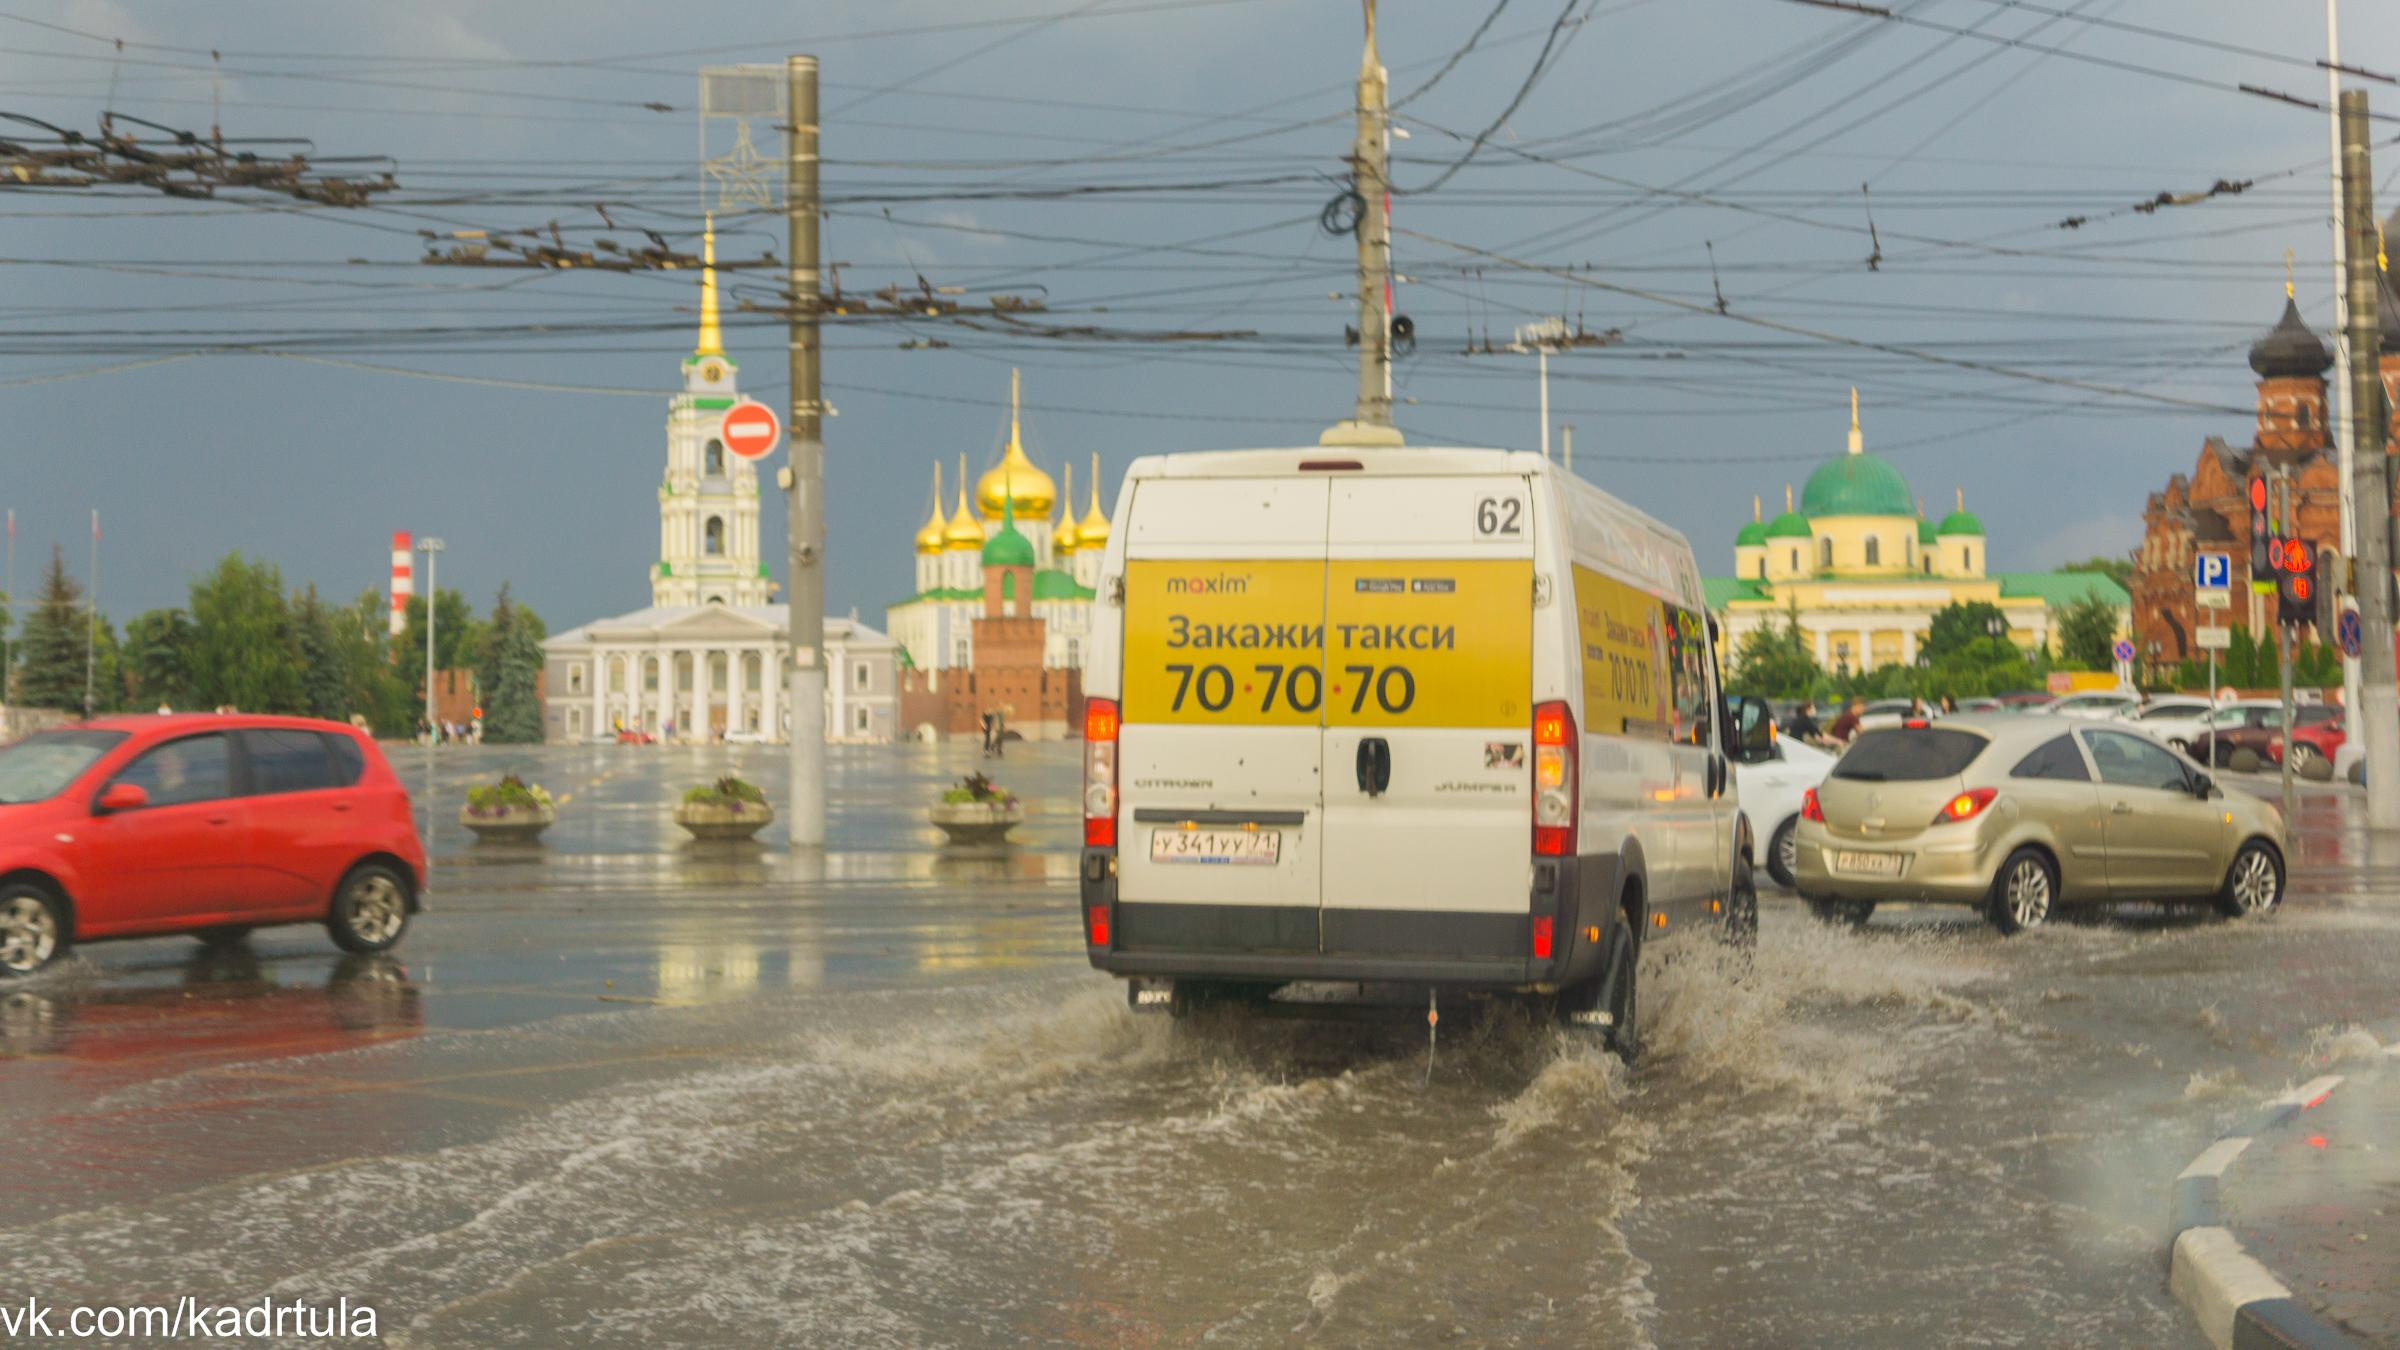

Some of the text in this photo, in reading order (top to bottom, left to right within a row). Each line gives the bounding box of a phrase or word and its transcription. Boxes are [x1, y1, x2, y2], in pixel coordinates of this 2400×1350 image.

[1477, 498, 1521, 534] 62
[1167, 573, 1247, 594] maxim
[2203, 556, 2223, 587] P
[1166, 614, 1455, 650] Закажи такси
